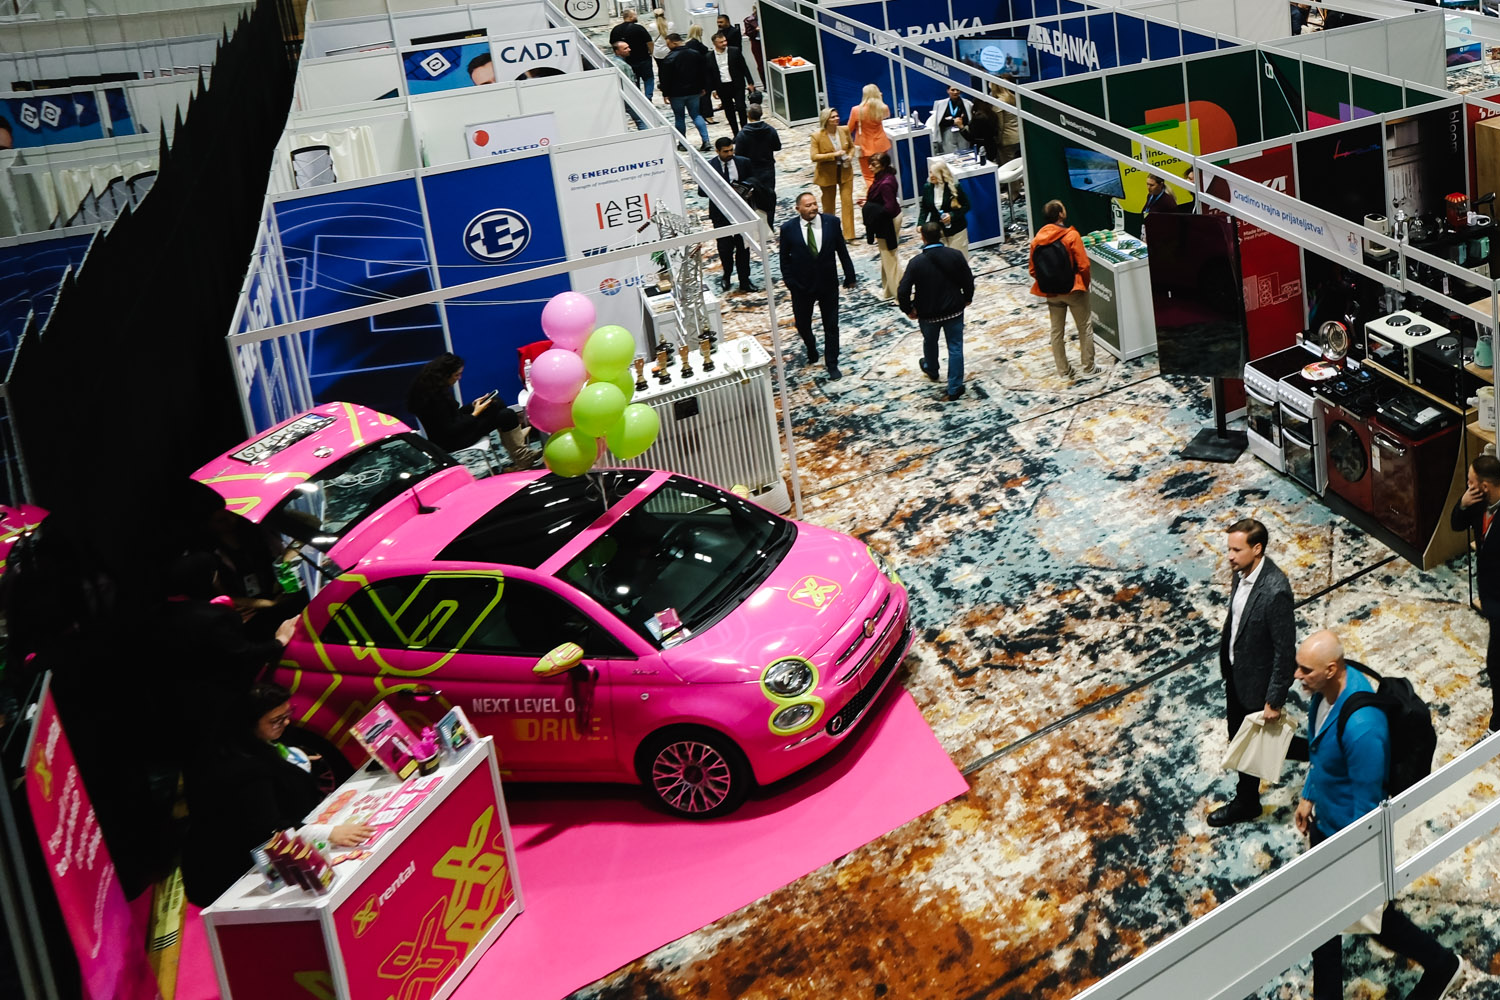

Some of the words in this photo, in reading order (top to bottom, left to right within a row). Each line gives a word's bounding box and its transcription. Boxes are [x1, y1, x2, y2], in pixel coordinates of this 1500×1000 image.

[572, 1, 594, 11] ICS
[1053, 30, 1101, 70] BANKA
[582, 158, 665, 180] ENERGOINVEST
[1233, 190, 1261, 209] Gradimo
[1261, 204, 1280, 218] trajna
[1282, 211, 1324, 236] prijateljstva!
[472, 698, 510, 712] NEXT
[515, 698, 560, 713] LEVEL
[379, 860, 416, 906] rental
